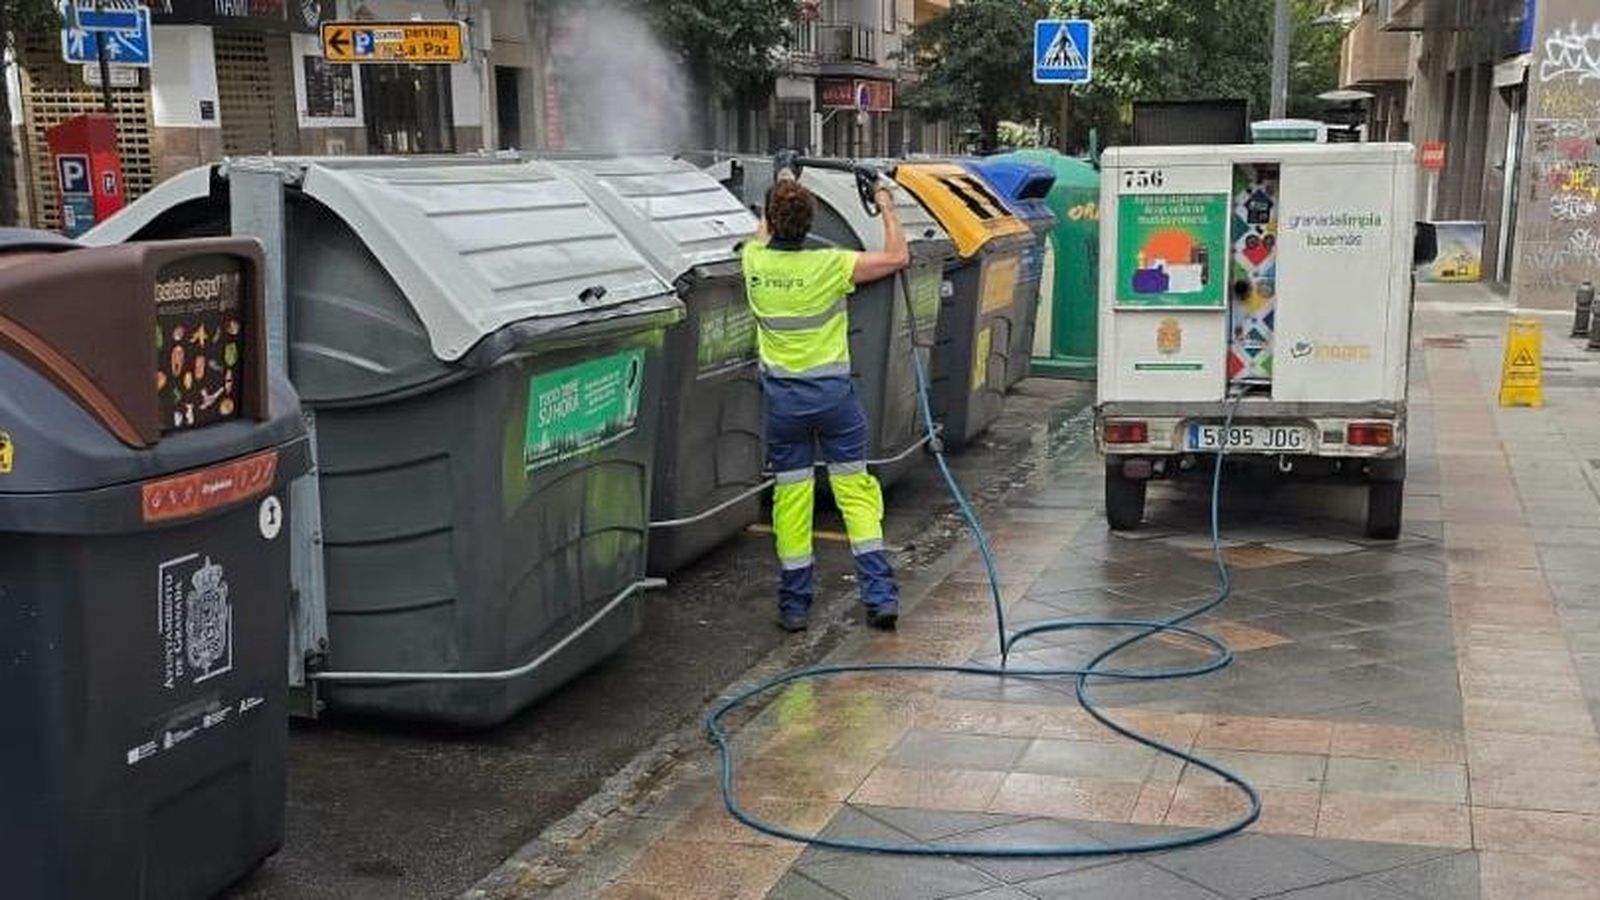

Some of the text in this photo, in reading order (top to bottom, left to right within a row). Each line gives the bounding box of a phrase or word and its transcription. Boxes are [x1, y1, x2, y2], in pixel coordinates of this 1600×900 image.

[424, 43, 449, 56] Paz
[62, 160, 84, 190] P
[1123, 170, 1163, 188] 756
